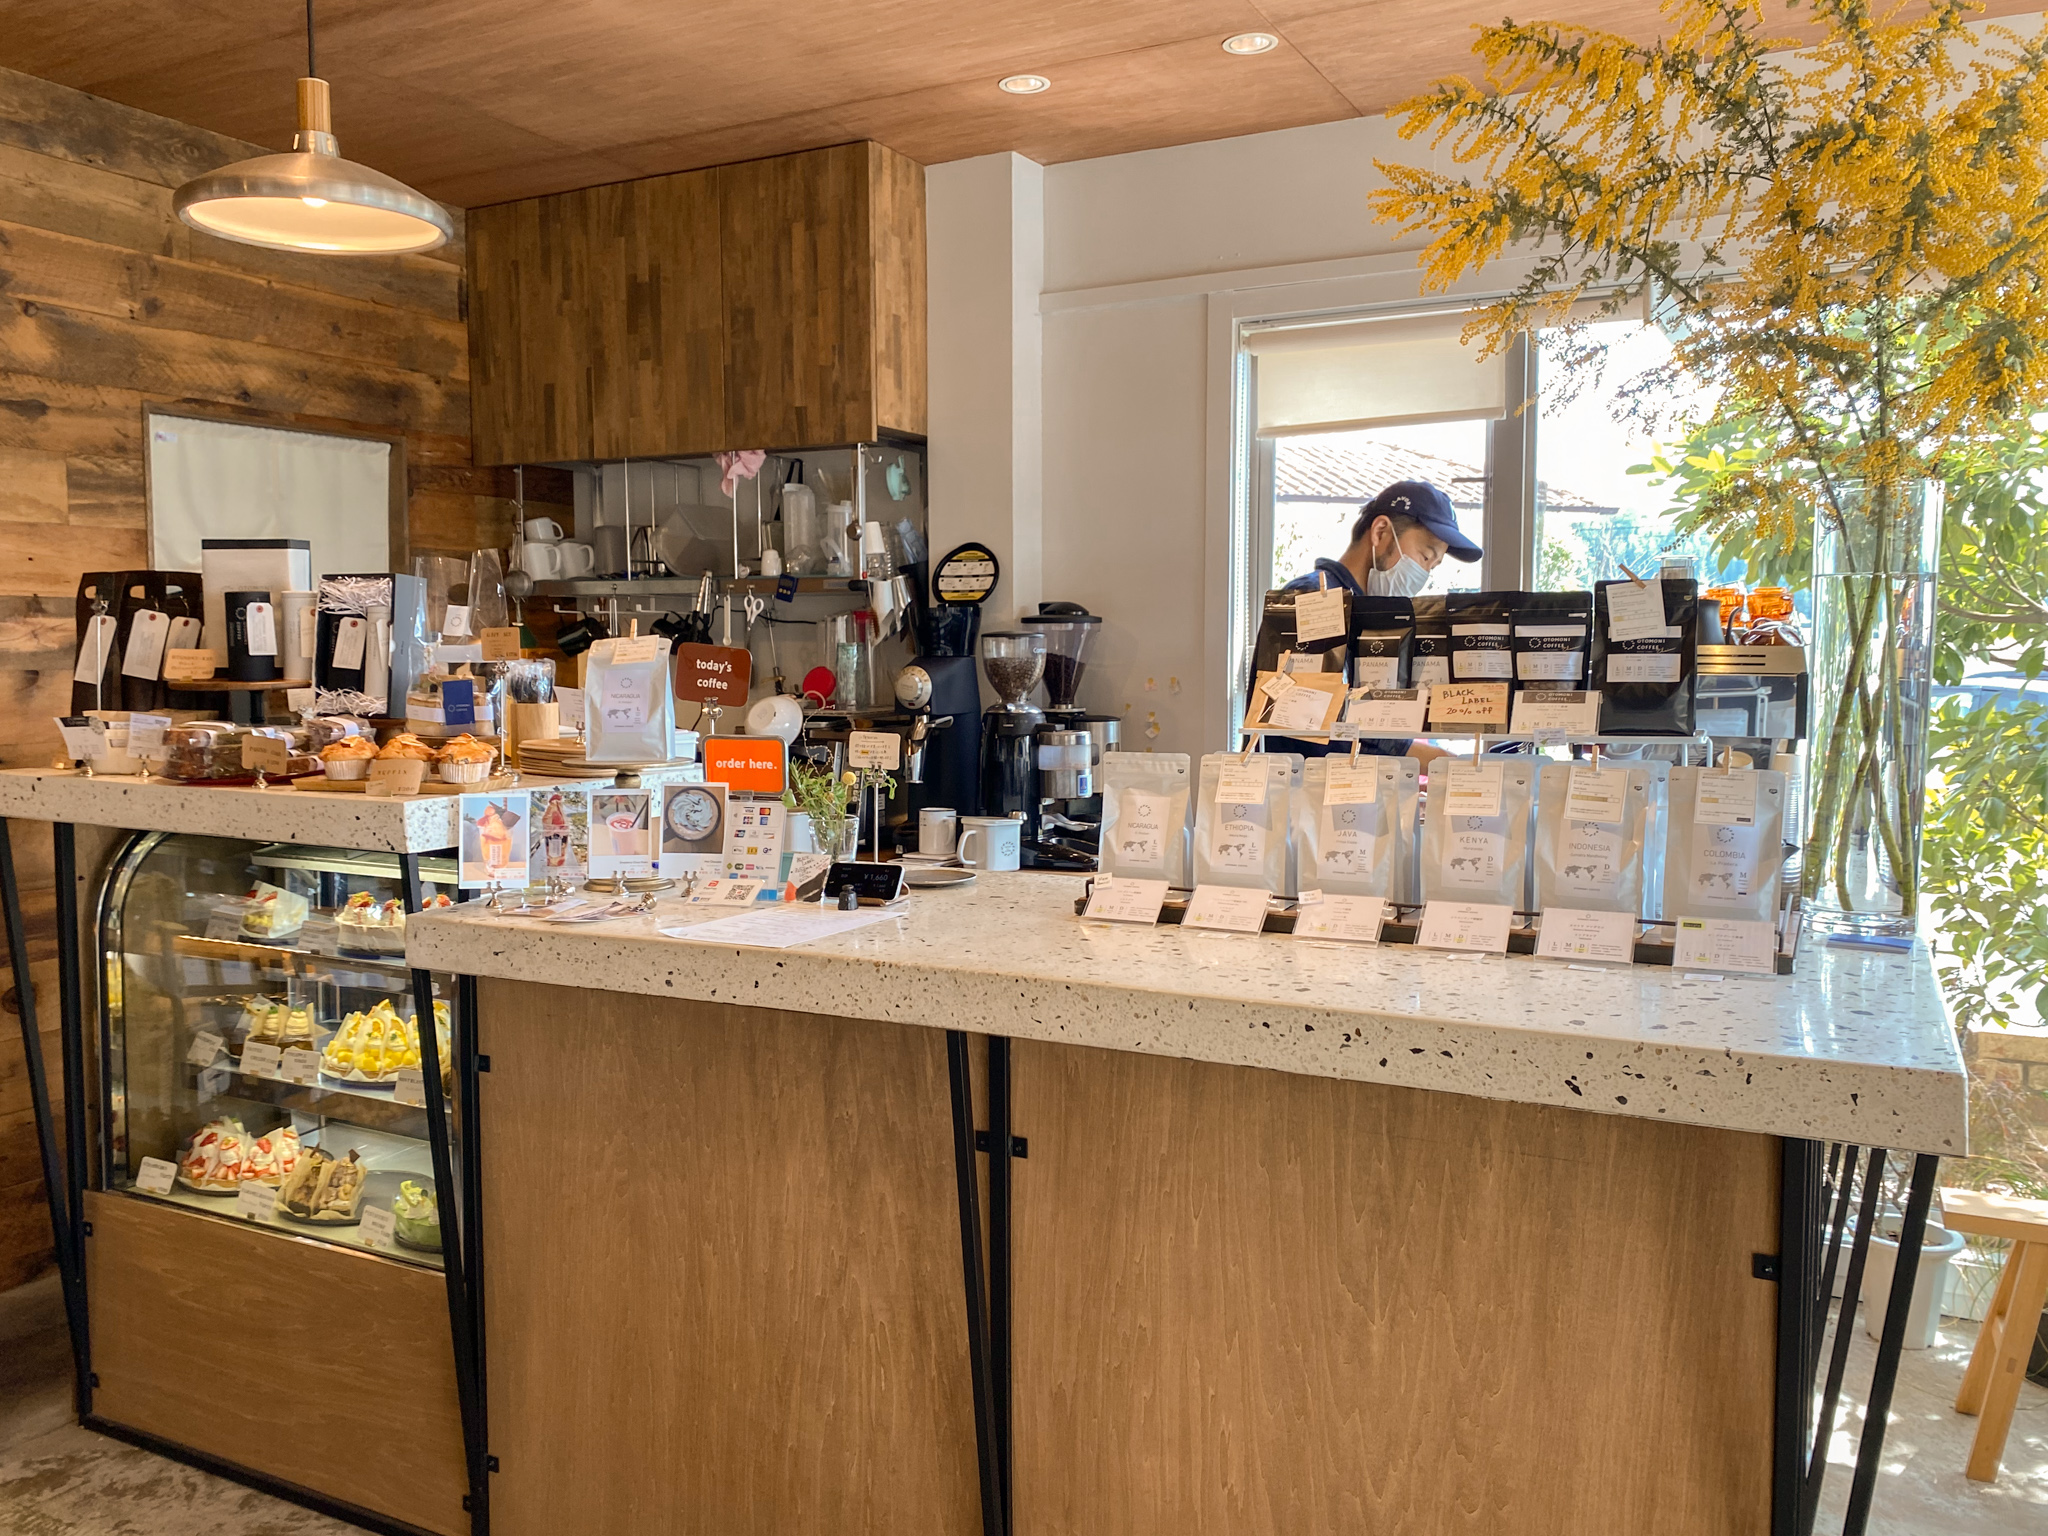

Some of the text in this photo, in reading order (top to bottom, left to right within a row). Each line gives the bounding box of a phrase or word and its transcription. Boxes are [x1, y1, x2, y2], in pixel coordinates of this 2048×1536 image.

[696, 658, 732, 674] today's
[696, 678, 728, 690] coffee
[1442, 688, 1475, 700] BLACK
[1462, 696, 1493, 704] LABEL
[1476, 706, 1493, 714] off
[716, 758, 778, 770] order here.
[1568, 842, 1611, 852] INDONESIA
[1703, 850, 1746, 859] COLOMBIA
